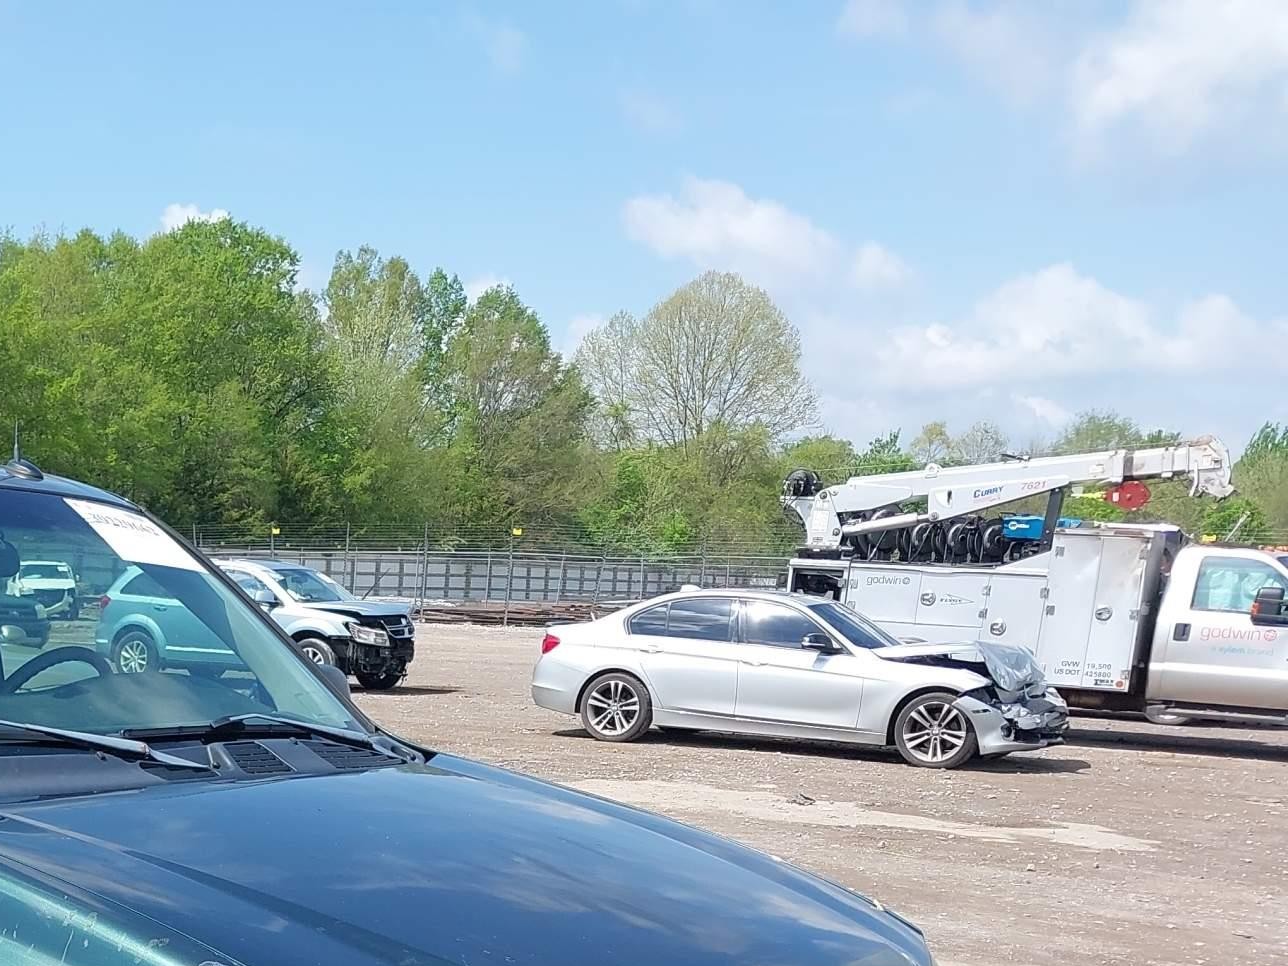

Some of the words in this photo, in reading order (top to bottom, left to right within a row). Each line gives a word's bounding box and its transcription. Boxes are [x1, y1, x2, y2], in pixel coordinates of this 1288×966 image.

[1021, 480, 1047, 491] 7621
[866, 575, 902, 586] godwin
[1200, 626, 1261, 641] godwin
[1061, 660, 1081, 668] GVW
